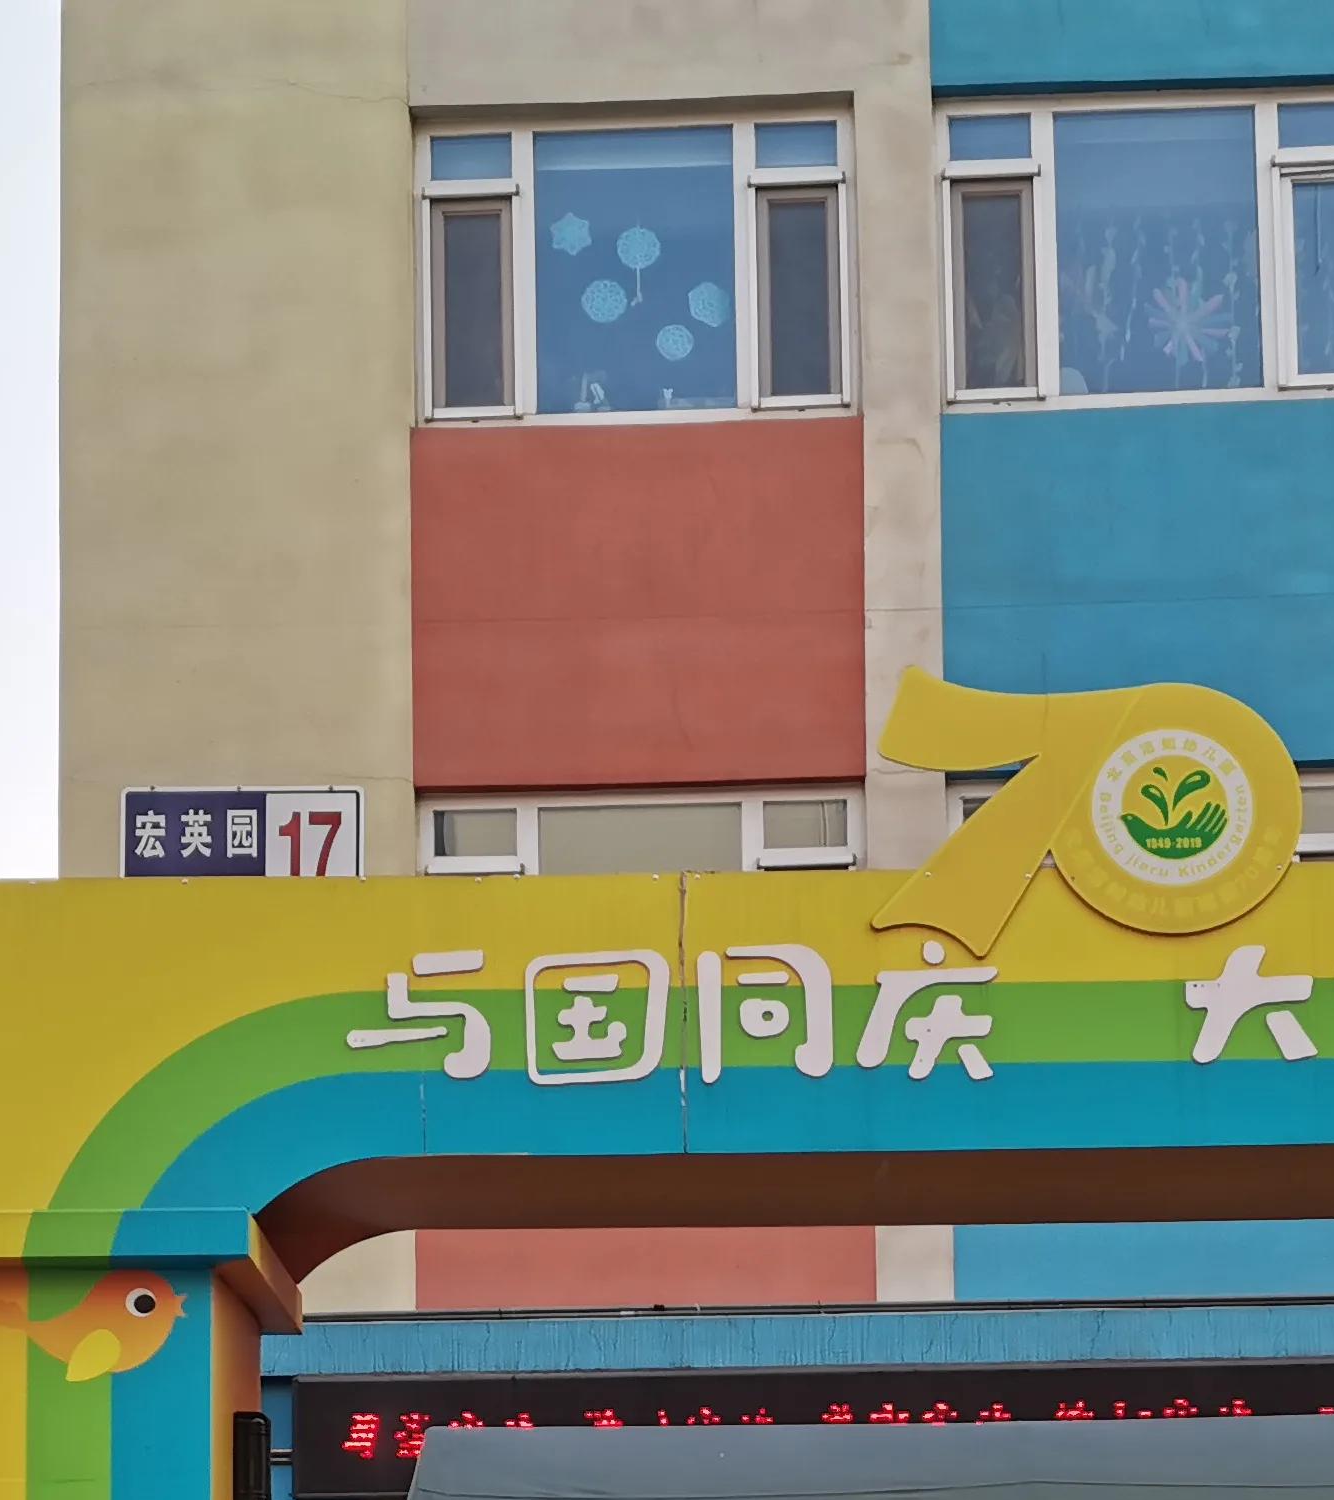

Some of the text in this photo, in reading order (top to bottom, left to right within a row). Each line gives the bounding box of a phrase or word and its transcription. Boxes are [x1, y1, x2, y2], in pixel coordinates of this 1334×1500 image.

[134, 808, 343, 877] 宏英园 17
[347, 940, 999, 1087] 与国同庆
